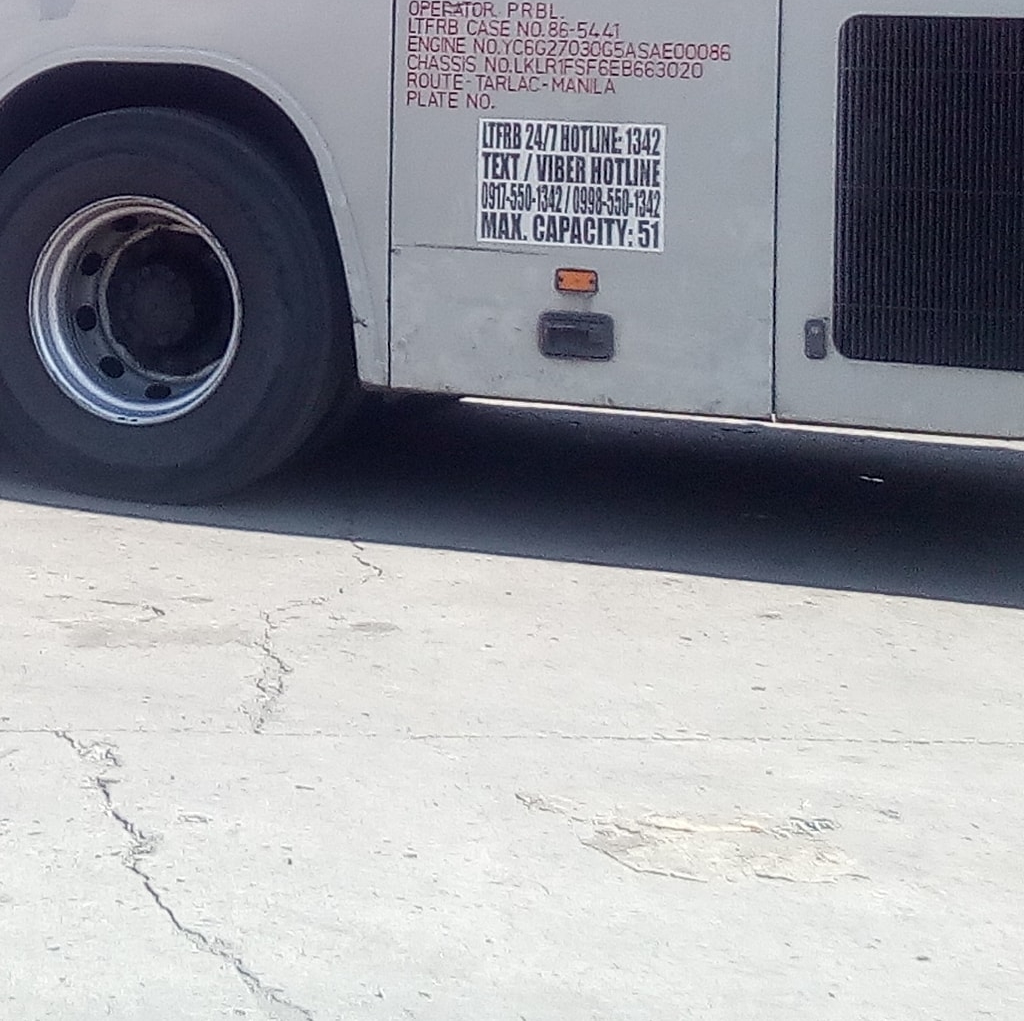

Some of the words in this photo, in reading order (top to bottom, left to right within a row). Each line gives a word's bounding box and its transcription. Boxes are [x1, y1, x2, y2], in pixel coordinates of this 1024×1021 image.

[408, 18, 459, 35] LTFRB
[466, 20, 510, 37] CASE
[407, 36, 466, 54] ENGINE
[407, 54, 476, 72] CHASSIS
[406, 91, 458, 109] PLATE
[466, 94, 495, 110] NO.
[482, 121, 521, 149] LTFRB
[525, 123, 558, 151] 24/7
[560, 124, 622, 155] HOTLINE:
[626, 128, 660, 156] 1342
[482, 151, 521, 180] TEXT
[536, 154, 586, 183] VIBER
[591, 156, 661, 187] HOTLINE
[481, 211, 527, 241] MAX.
[532, 214, 633, 247] CAPACITY:
[637, 219, 659, 248] 51
